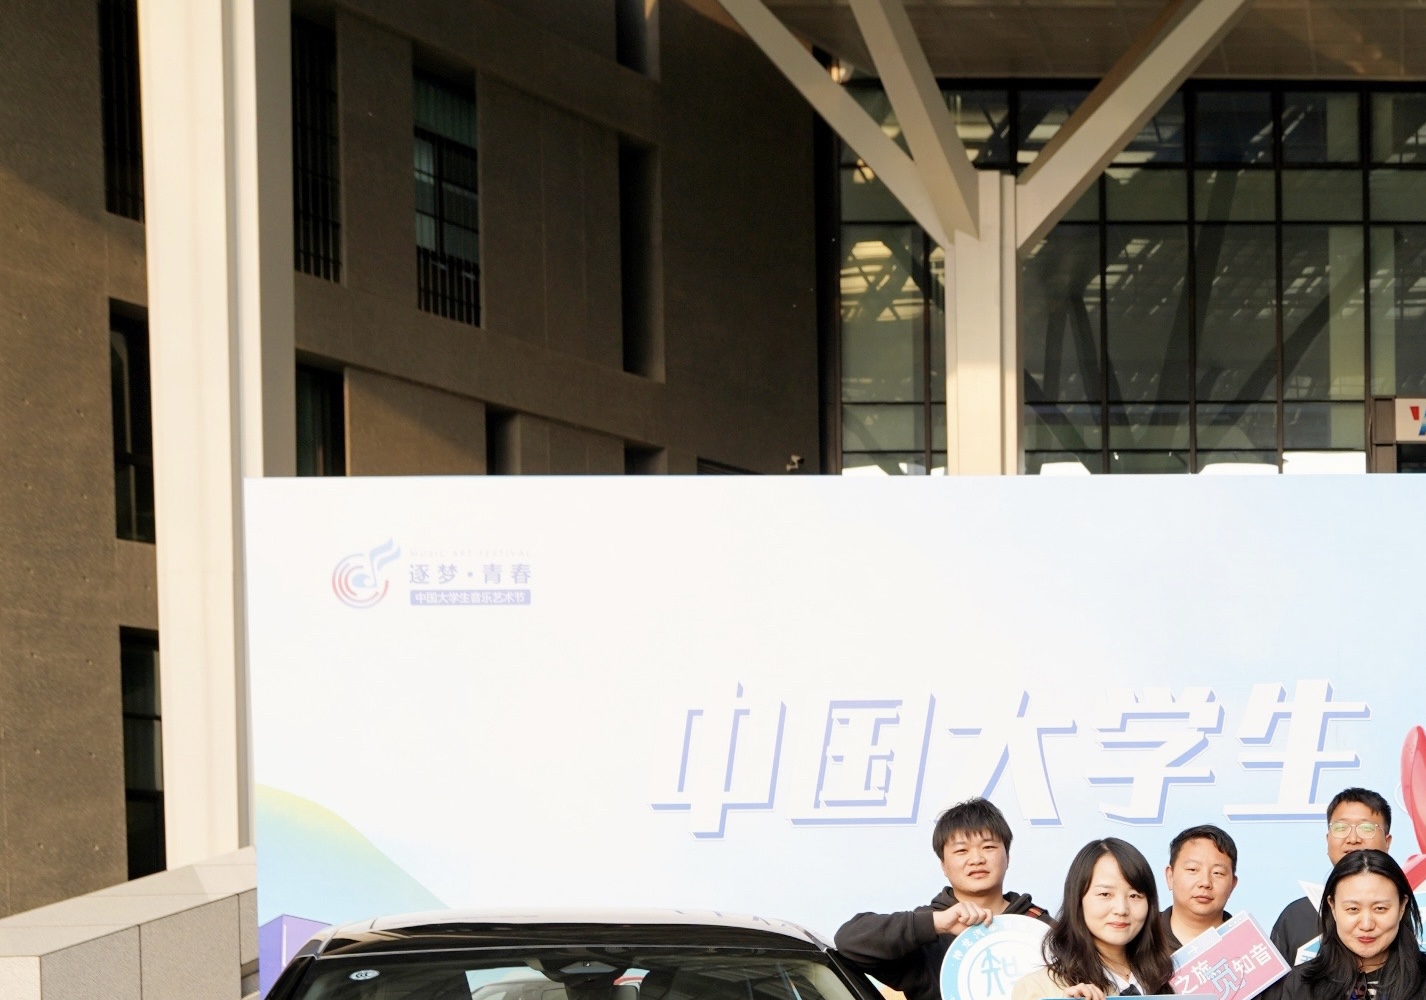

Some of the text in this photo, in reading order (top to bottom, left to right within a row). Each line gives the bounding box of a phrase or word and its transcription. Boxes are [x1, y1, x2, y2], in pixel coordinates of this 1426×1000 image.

[414, 590, 527, 605] 中国大学生音乐艺术节
[646, 680, 1373, 840] 中国大学生
